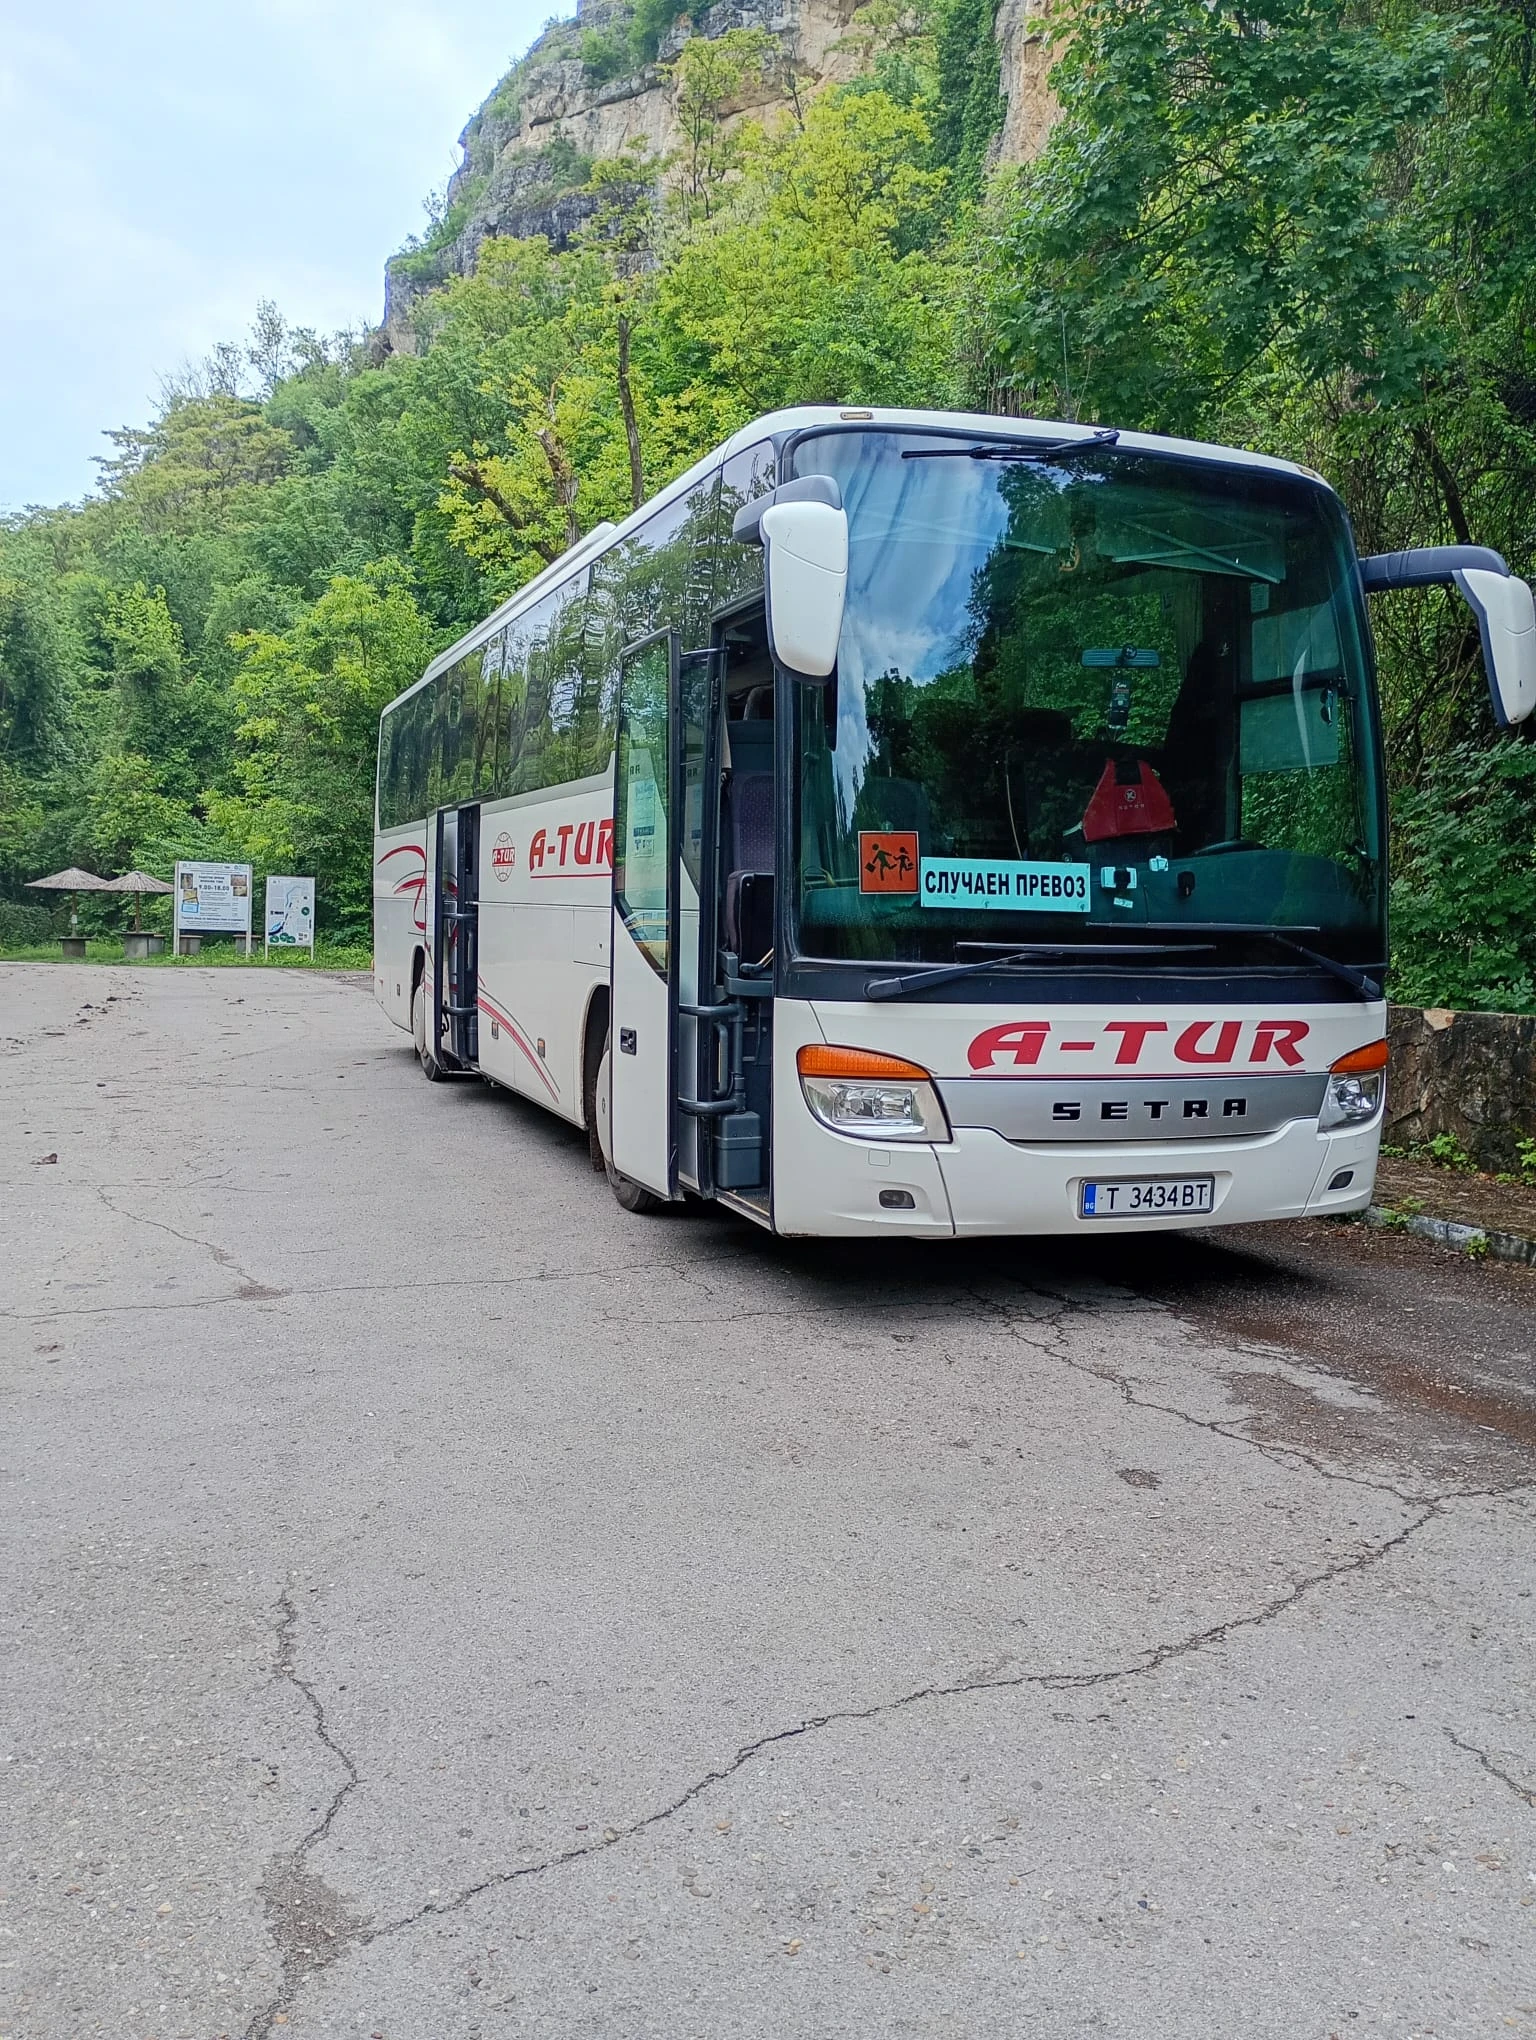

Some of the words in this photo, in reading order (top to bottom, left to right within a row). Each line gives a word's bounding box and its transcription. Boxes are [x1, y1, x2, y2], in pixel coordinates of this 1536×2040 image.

[493, 849, 515, 863] A-TUR
[529, 818, 613, 871] A-TUR
[925, 871, 1009, 895] СЛУЧАЕН
[1016, 874, 1085, 898] ПРЕВОЗ
[967, 1021, 1310, 1071] A-TUR
[1052, 1098, 1248, 1121] SETRA
[1085, 1202, 1095, 1210] BG
